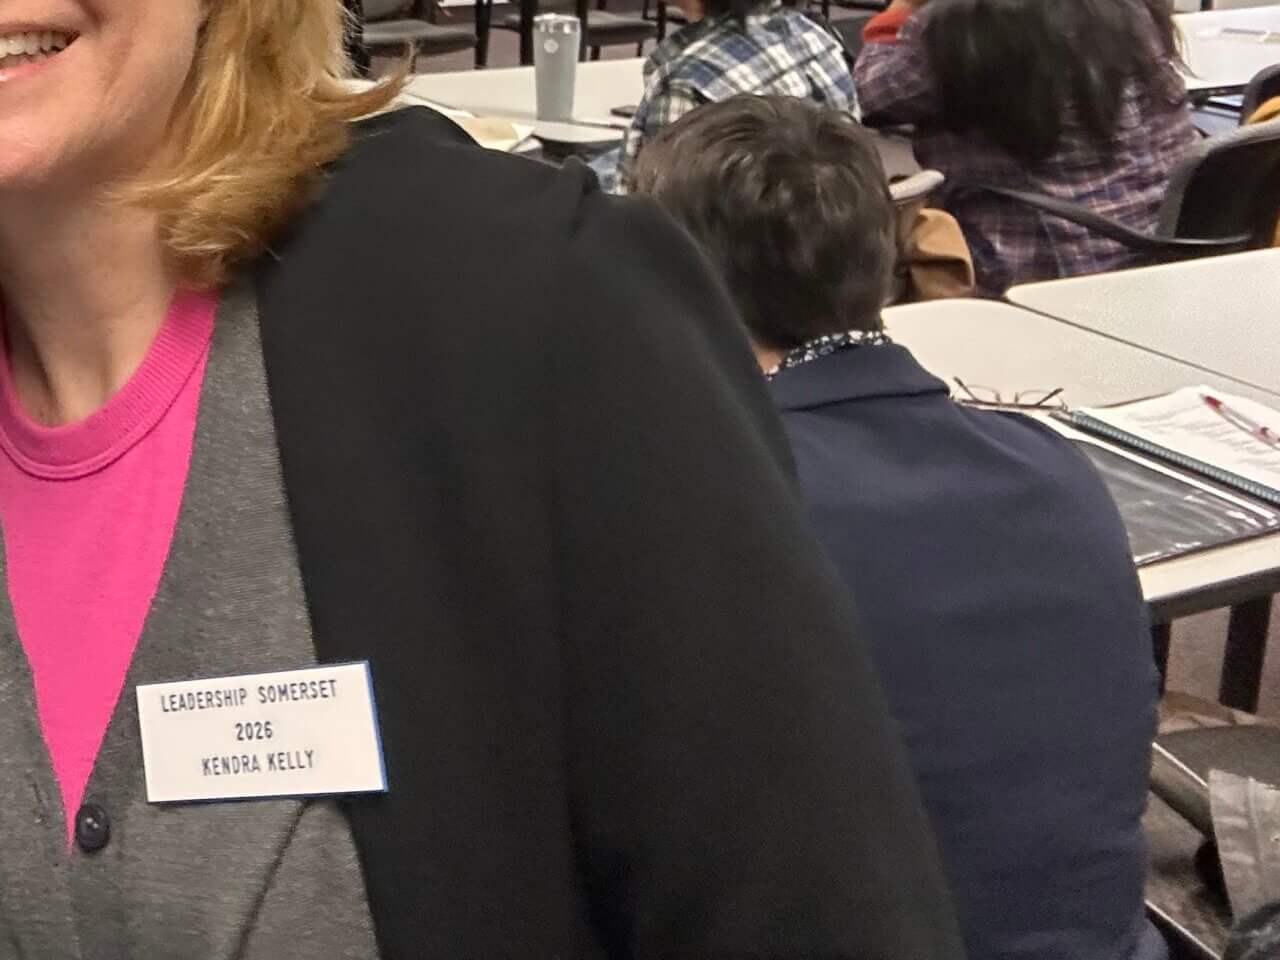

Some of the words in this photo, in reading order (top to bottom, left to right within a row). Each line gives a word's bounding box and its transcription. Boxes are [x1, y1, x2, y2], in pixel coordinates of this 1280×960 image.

[161, 688, 247, 712] LEADERSHIP
[259, 679, 337, 704] SOMERSET
[235, 721, 273, 741] 2026
[202, 754, 261, 776] KENDRA
[268, 750, 315, 771] KELLY
